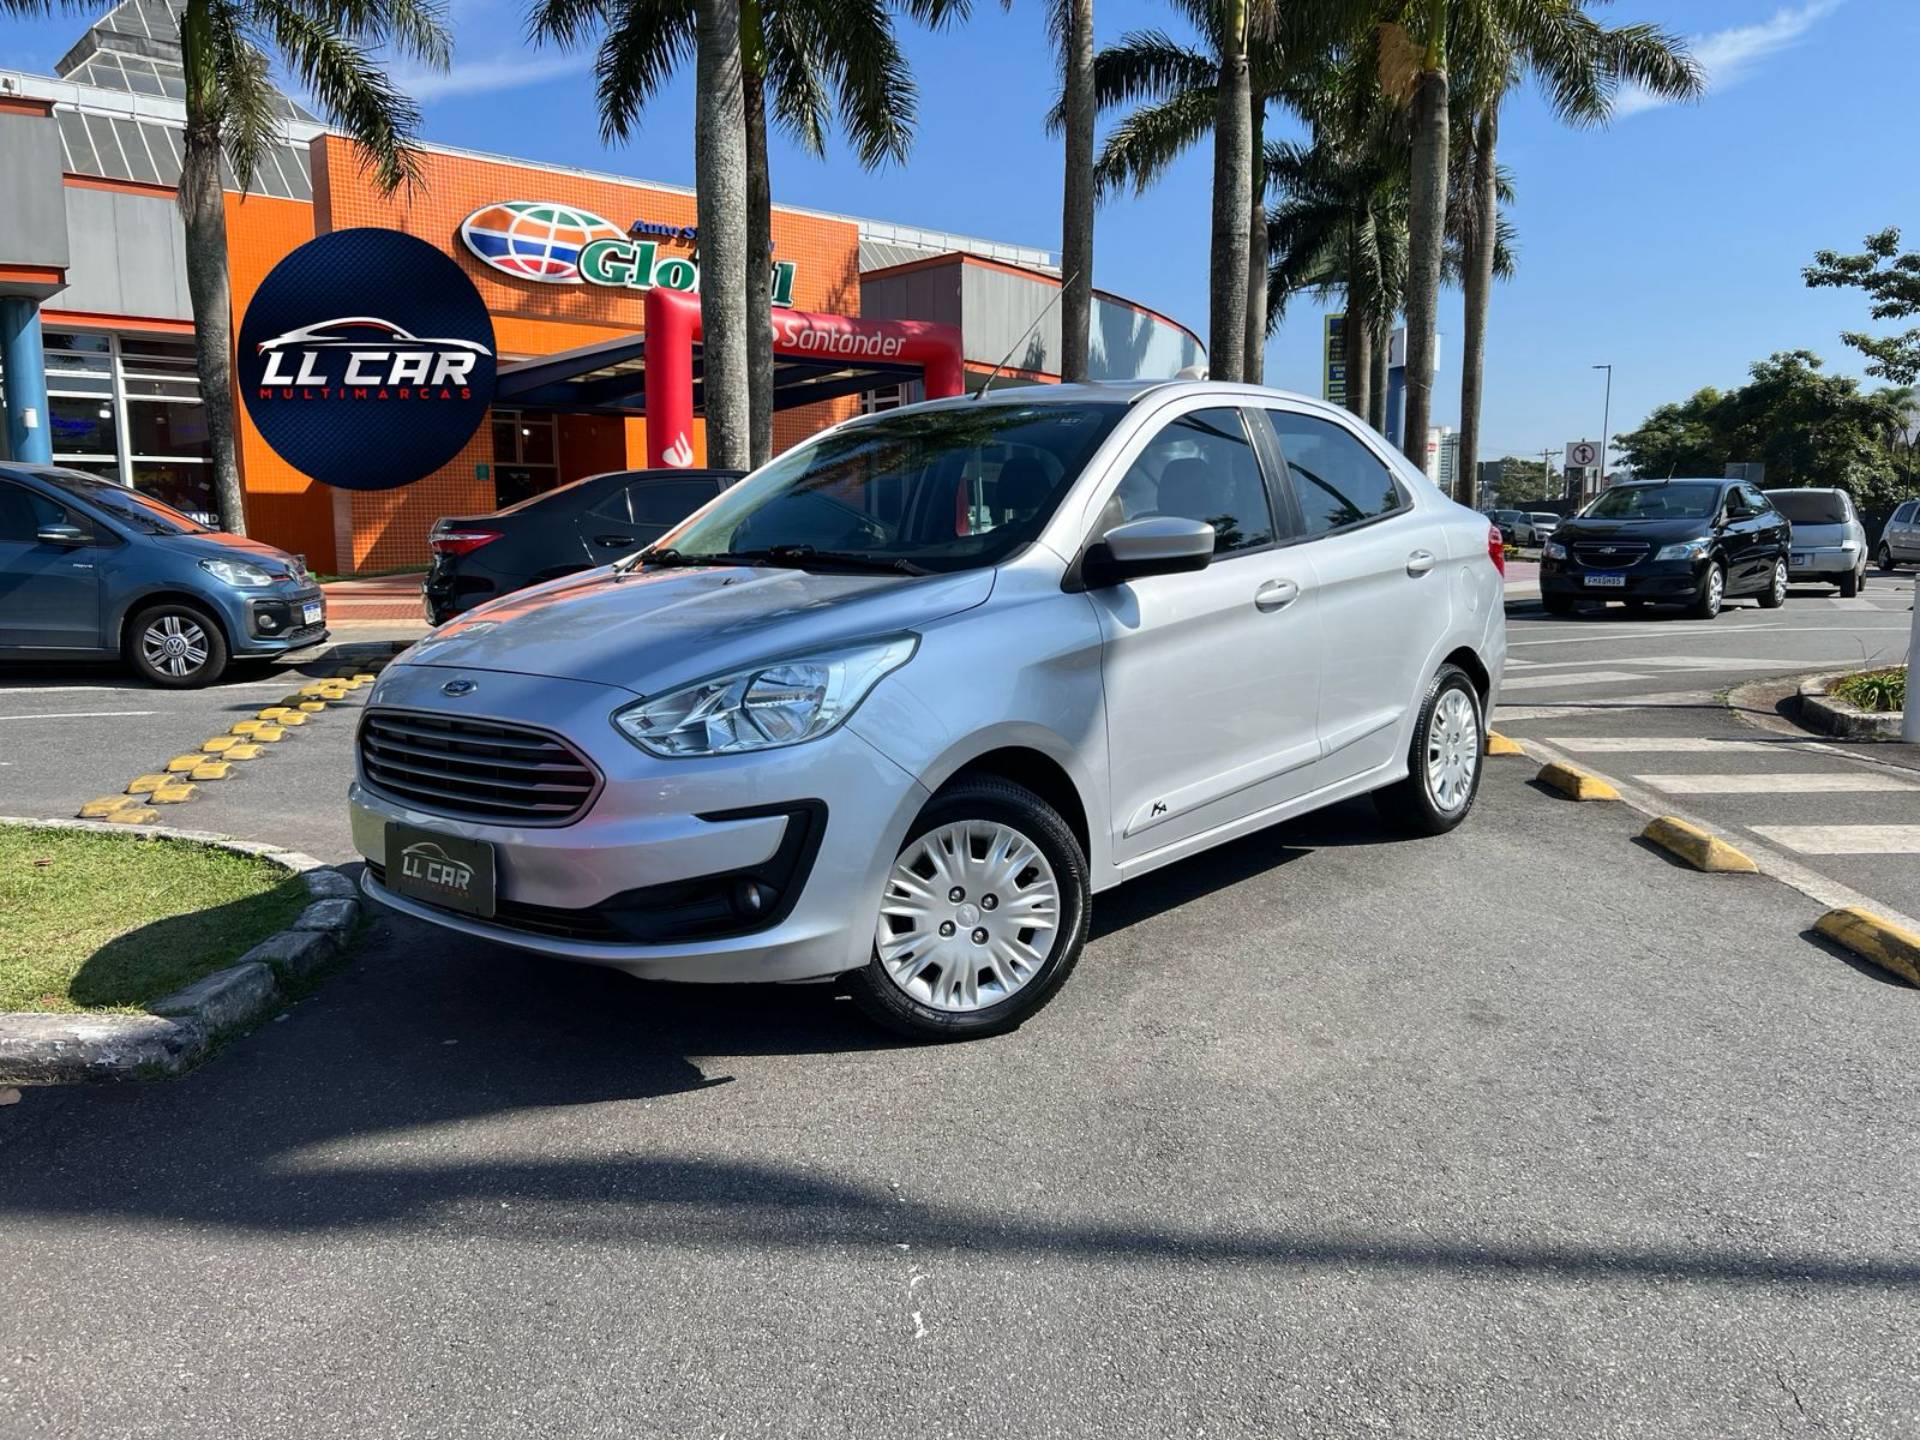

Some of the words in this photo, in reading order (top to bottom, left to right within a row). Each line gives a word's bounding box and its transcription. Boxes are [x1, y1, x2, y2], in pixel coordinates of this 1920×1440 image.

[632, 220, 680, 239] Auto
[578, 239, 796, 307] Glol
[781, 319, 906, 356] Santander
[402, 855, 422, 879] LL
[427, 862, 470, 890] CAR
